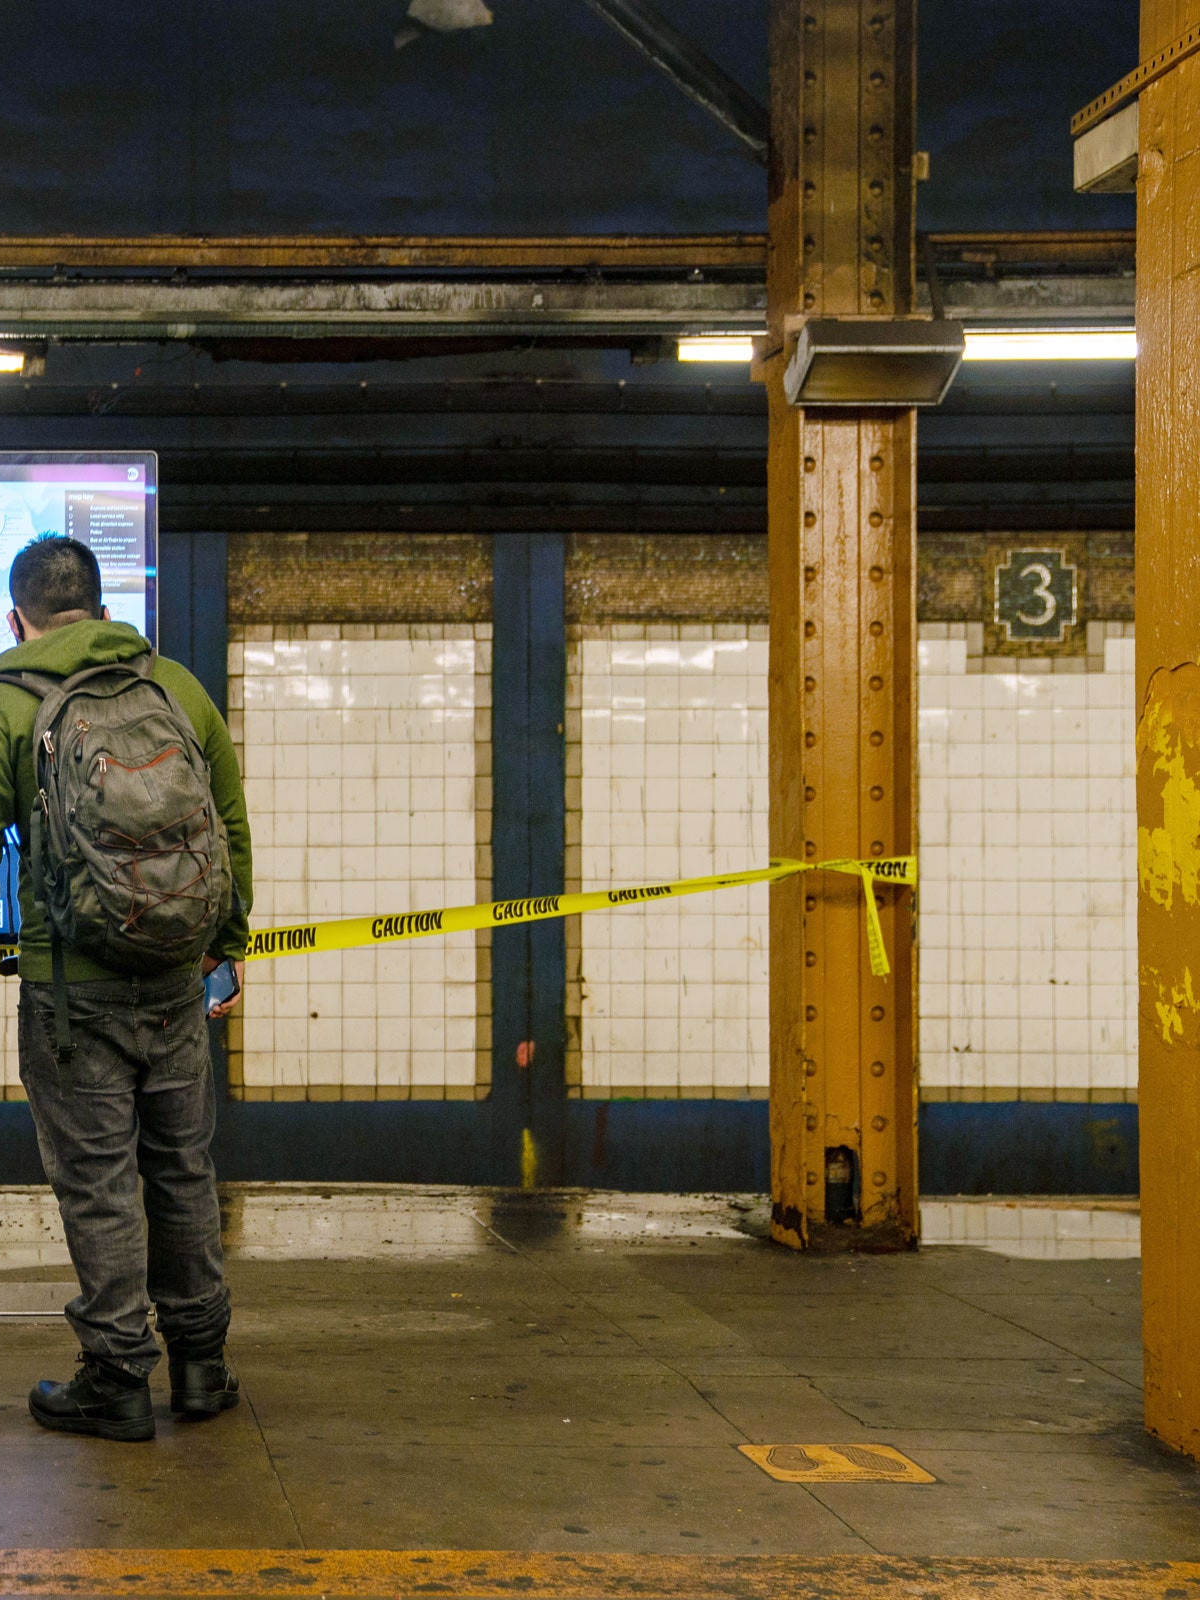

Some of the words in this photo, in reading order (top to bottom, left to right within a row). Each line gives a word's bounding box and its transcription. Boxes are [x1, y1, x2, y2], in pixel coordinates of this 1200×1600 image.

[1016, 562, 1056, 626] 3
[372, 911, 444, 939] CAUTION
[492, 896, 560, 920] CAUTION
